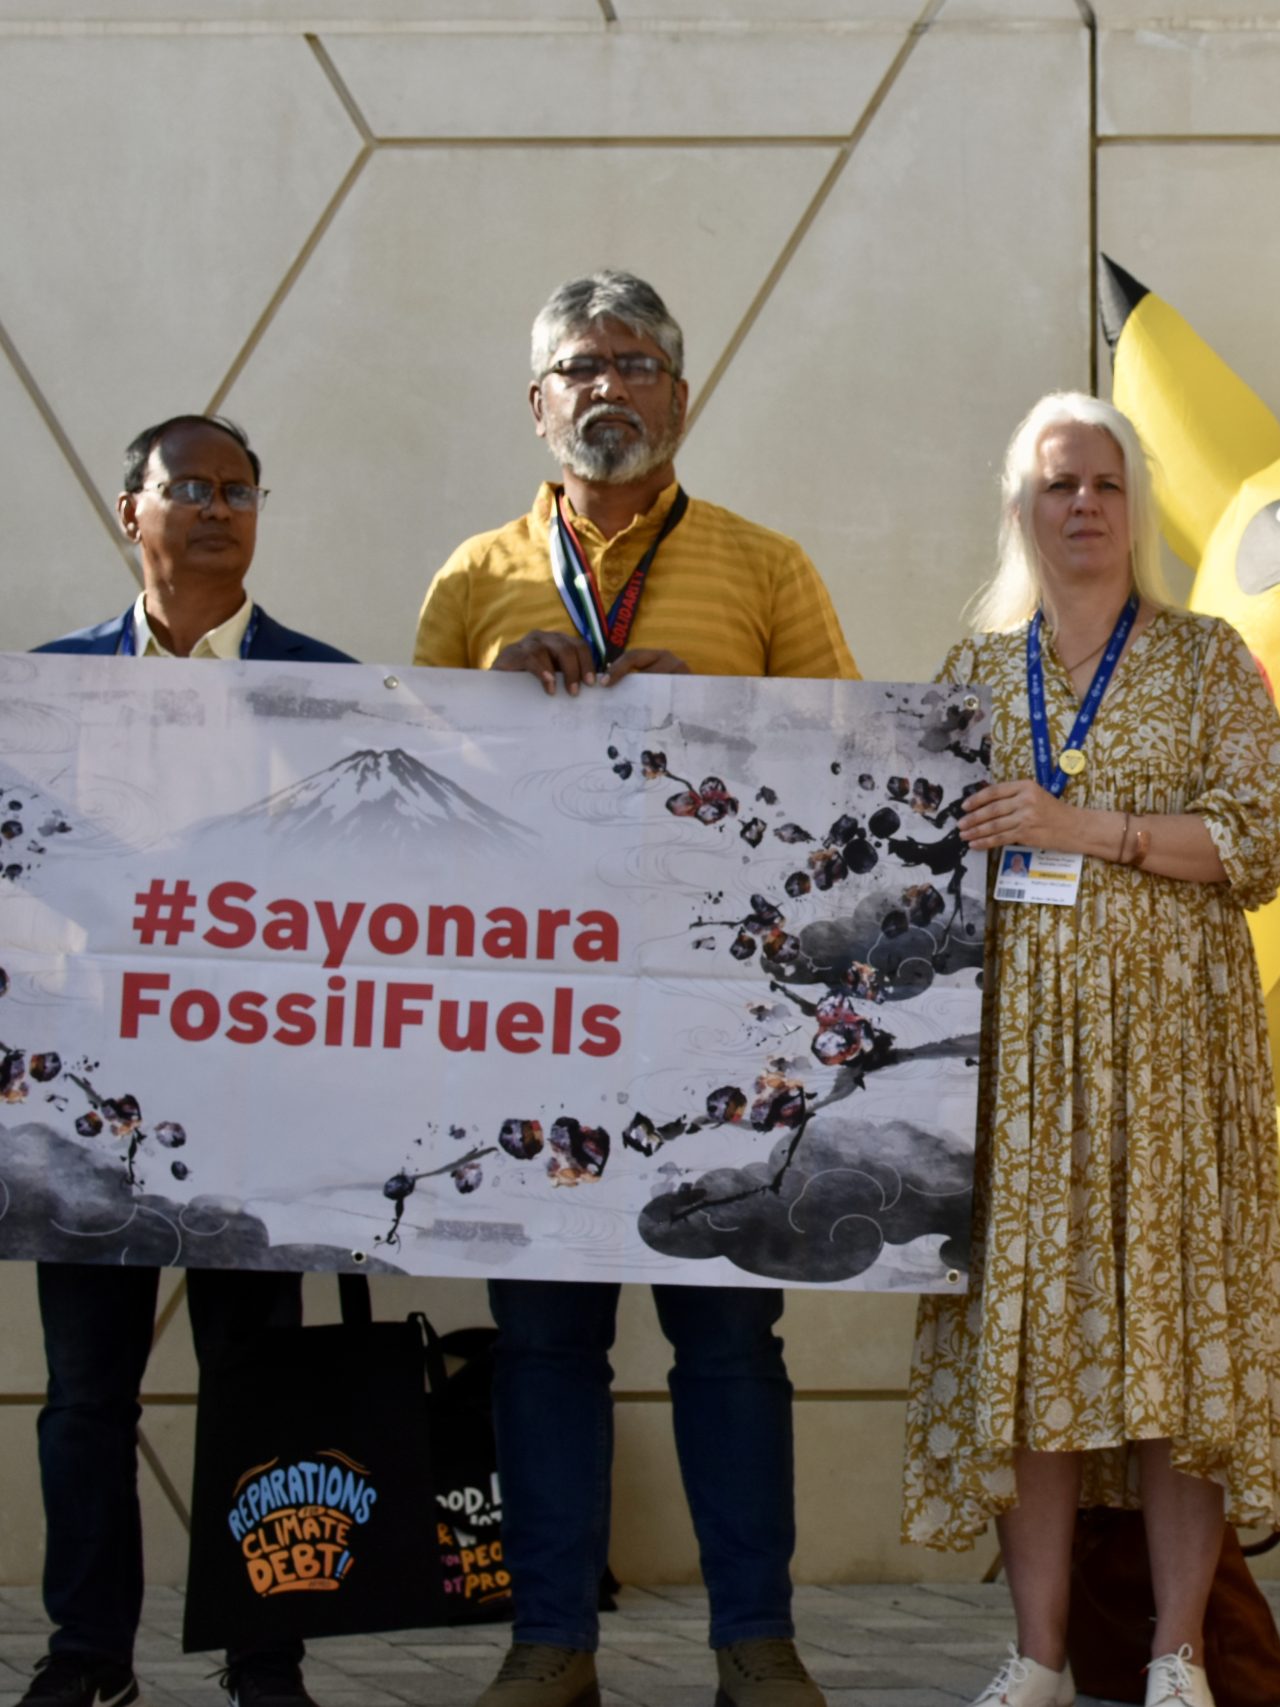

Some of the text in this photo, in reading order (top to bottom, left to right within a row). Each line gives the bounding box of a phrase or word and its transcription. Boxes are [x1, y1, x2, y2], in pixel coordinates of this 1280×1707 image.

[609, 570, 646, 648] SOLIDARITY
[132, 878, 620, 969] #Sayonara
[119, 971, 623, 1057] FossilFuels
[228, 1460, 378, 1541] REPARATIONS
[241, 1514, 350, 1559] CLIMATE
[460, 1540, 503, 1574] PEO
[464, 1569, 511, 1600] PRO
